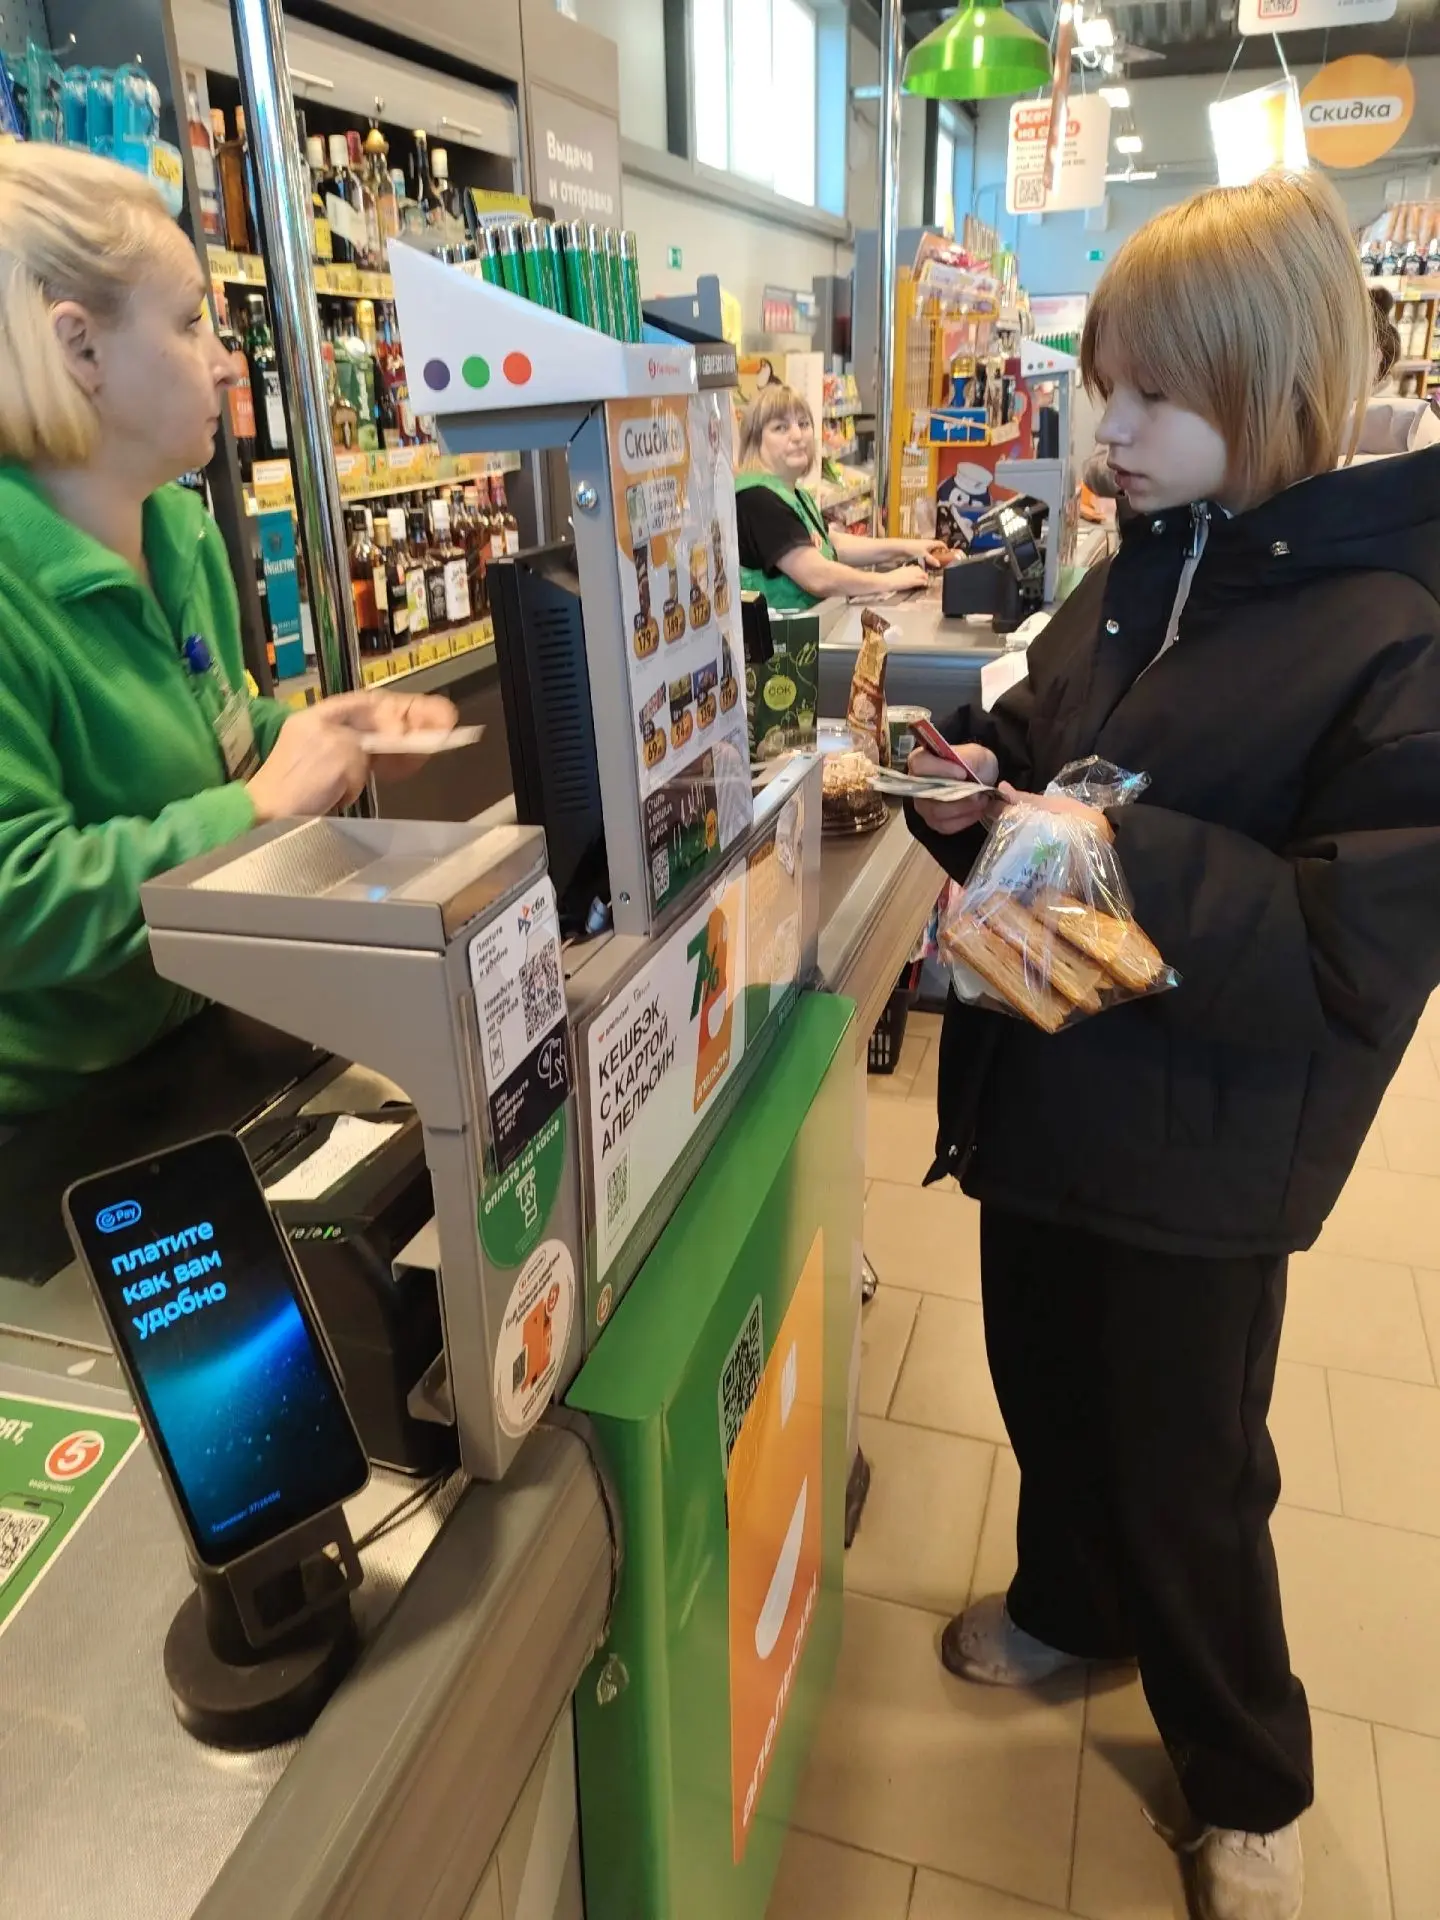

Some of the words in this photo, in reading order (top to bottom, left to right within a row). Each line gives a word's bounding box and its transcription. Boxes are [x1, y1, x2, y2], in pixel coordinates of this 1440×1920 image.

[1308, 101, 1391, 123] Скидка
[546, 129, 594, 173] Выдача
[548, 177, 558, 200] и
[560, 181, 614, 216] отправка
[476, 926, 503, 954] Платите
[478, 946, 497, 967] легко
[485, 947, 509, 975] удобно
[598, 993, 660, 1089] КЕШБЭК
[599, 1092, 612, 1121] С
[614, 1010, 669, 1106] КАРТОЙ
[521, 1149, 534, 1172] на
[115, 1206, 137, 1223] Pay
[110, 1220, 215, 1276] платите
[122, 1269, 172, 1306] как
[173, 1249, 223, 1285] вам
[131, 1279, 227, 1341] удобно
